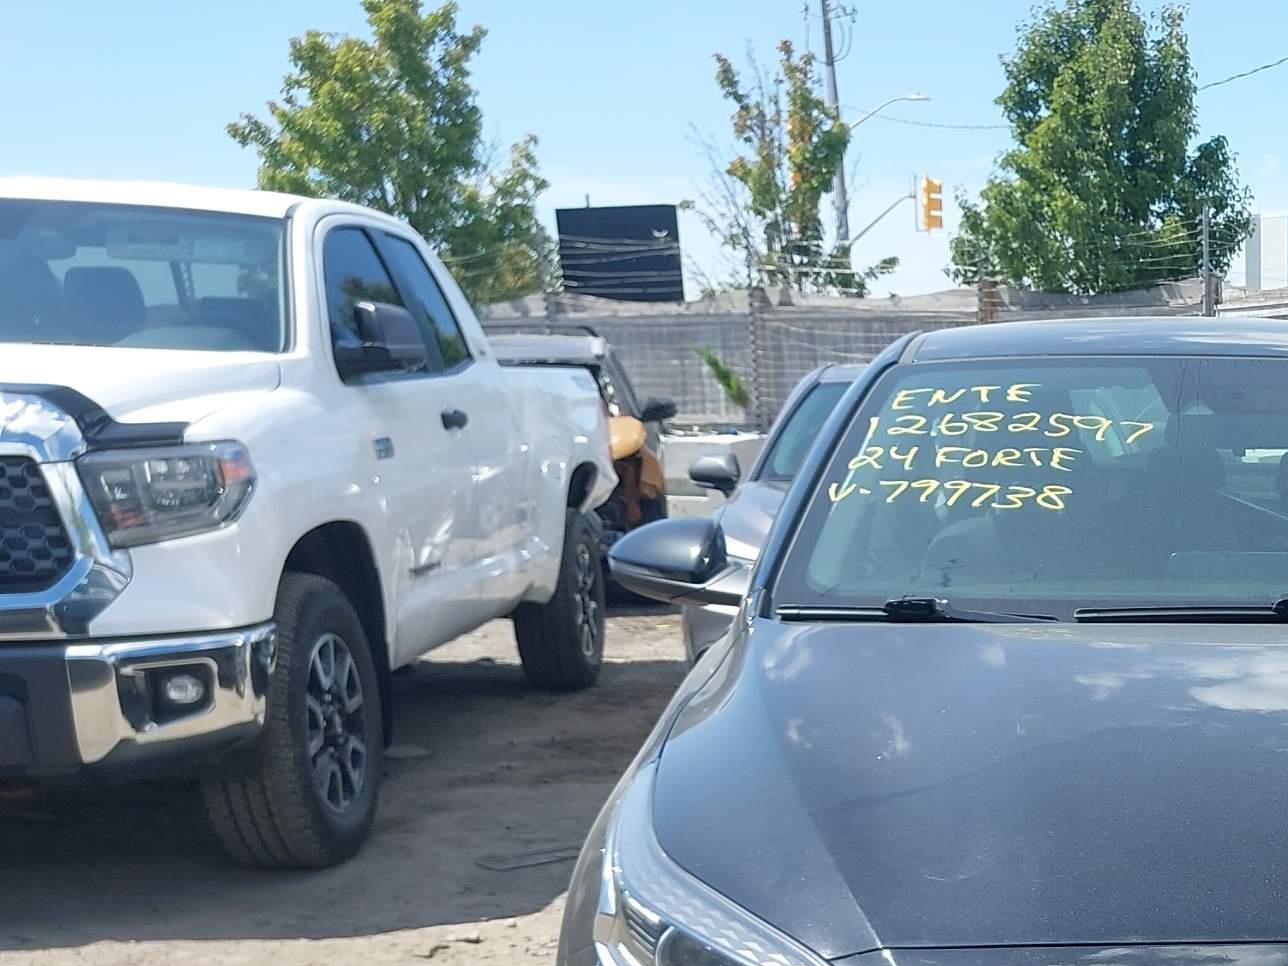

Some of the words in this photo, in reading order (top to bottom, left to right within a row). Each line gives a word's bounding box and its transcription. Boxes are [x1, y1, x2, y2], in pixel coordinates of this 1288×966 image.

[890, 383, 1042, 410] ENTE
[868, 411, 1154, 444] 12682597
[848, 447, 918, 470] 24
[934, 447, 1084, 472] FORTE
